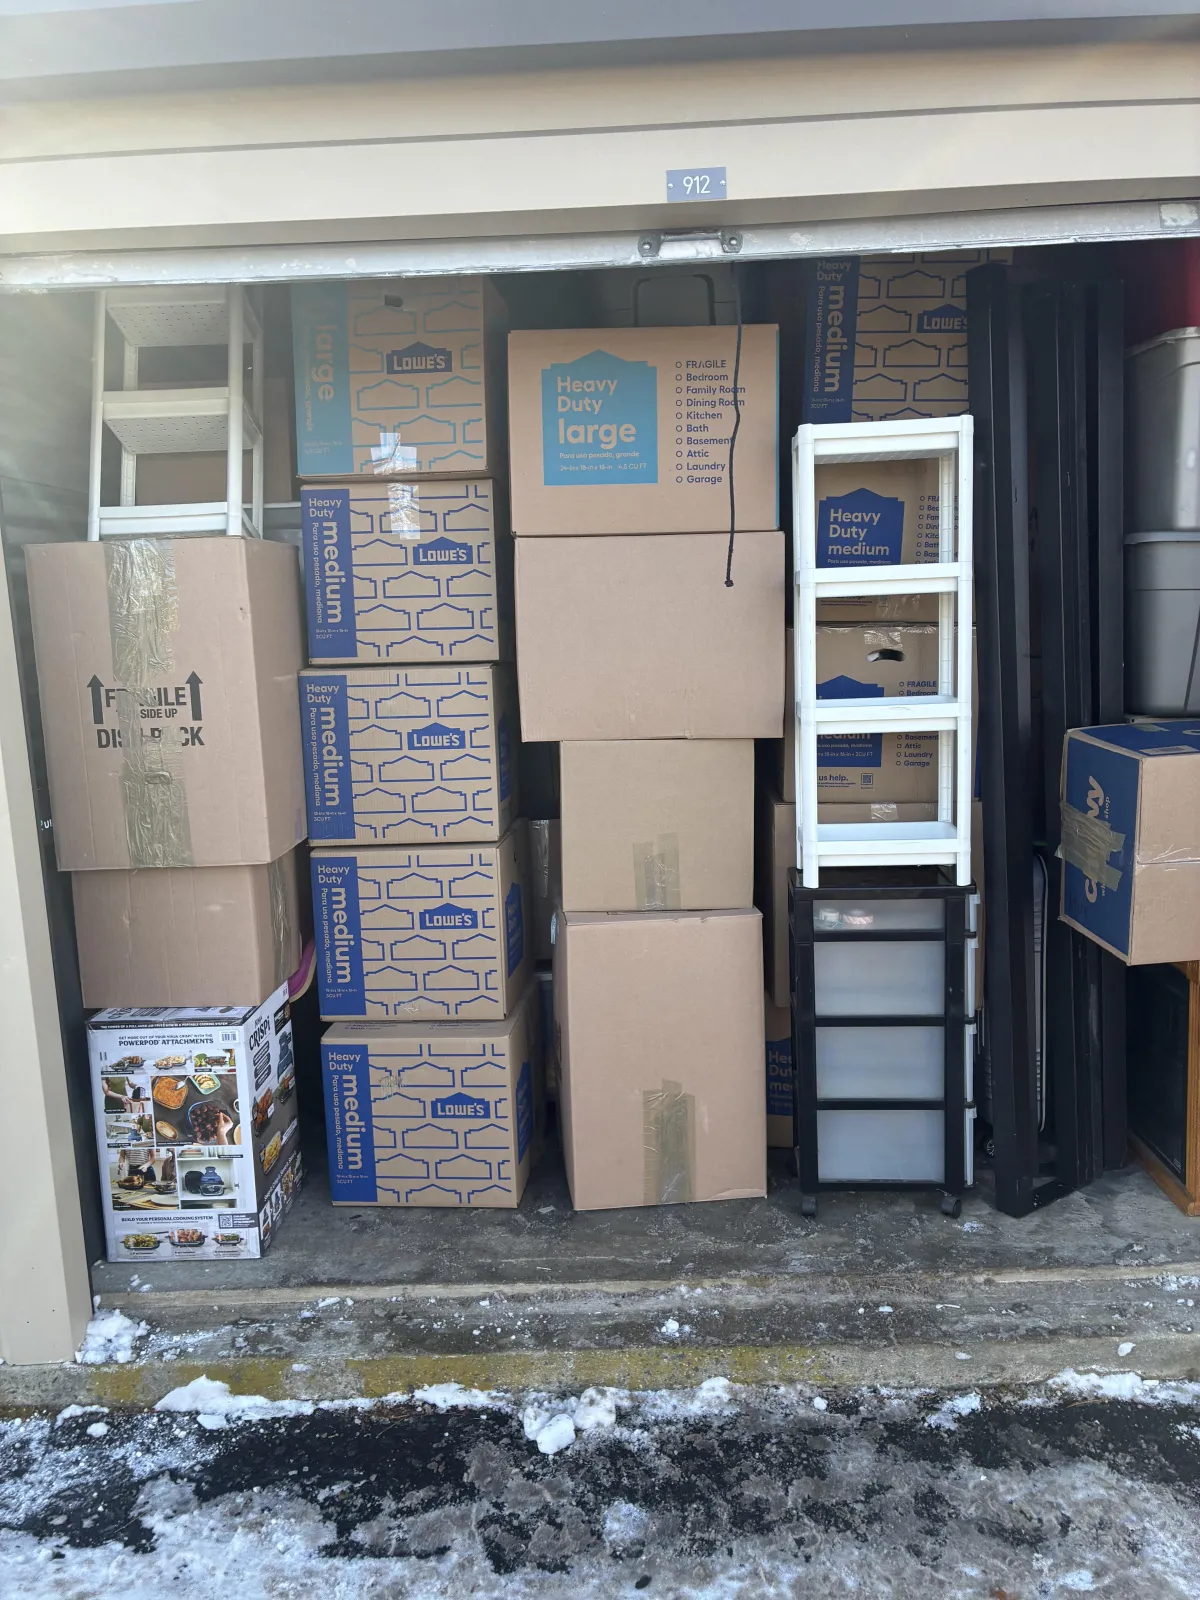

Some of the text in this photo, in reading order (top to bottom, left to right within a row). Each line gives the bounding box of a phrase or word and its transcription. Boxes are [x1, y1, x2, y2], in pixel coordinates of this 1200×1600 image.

[683, 175, 710, 194] 912
[817, 261, 851, 272] Heavy
[816, 271, 842, 282] Duty
[817, 286, 826, 304] Para
[824, 285, 848, 392] medium
[311, 325, 338, 402] large
[393, 354, 447, 371] LOWE'S
[686, 360, 727, 369] FRAGILE
[686, 373, 728, 382] Bedroom
[813, 357, 821, 392] mediana
[557, 376, 618, 396] Heavy
[686, 386, 717, 396] Family
[557, 396, 603, 415] Duty
[686, 399, 717, 408] Dining
[686, 411, 723, 420] Kitchen
[558, 418, 637, 450] large
[686, 424, 709, 433] Bath
[616, 451, 640, 460] grande
[687, 449, 710, 458] Attic
[687, 462, 726, 472] Laundry
[687, 475, 723, 485] Garage
[308, 498, 342, 508] Heavy
[309, 508, 335, 518] Duty
[830, 508, 881, 525] Heavy
[829, 525, 867, 540] Duty
[419, 547, 468, 562] LOWE'S
[828, 542, 889, 556] medium
[313, 558, 321, 588] pesado,
[322, 521, 346, 623] medium
[315, 589, 323, 623] mediana
[306, 683, 340, 694] Heavy
[307, 694, 332, 704] Duty
[140, 708, 178, 719] SIDE UP
[413, 732, 461, 747] LOWE'S
[311, 742, 320, 771] pesado,
[320, 707, 344, 806] medium
[829, 774, 848, 782] help.
[313, 772, 321, 806] mediana
[317, 865, 350, 875] Heavy
[318, 875, 343, 884] Duty
[425, 912, 473, 927] LOWE'S
[323, 921, 331, 950] pesado,
[331, 887, 355, 984] medium
[325, 950, 333, 984] mediana
[328, 1052, 361, 1062] Heavy
[328, 1062, 354, 1072] Duty
[437, 1102, 485, 1116] LOWE'S
[334, 1107, 342, 1136] pesado,
[342, 1074, 366, 1170] medium
